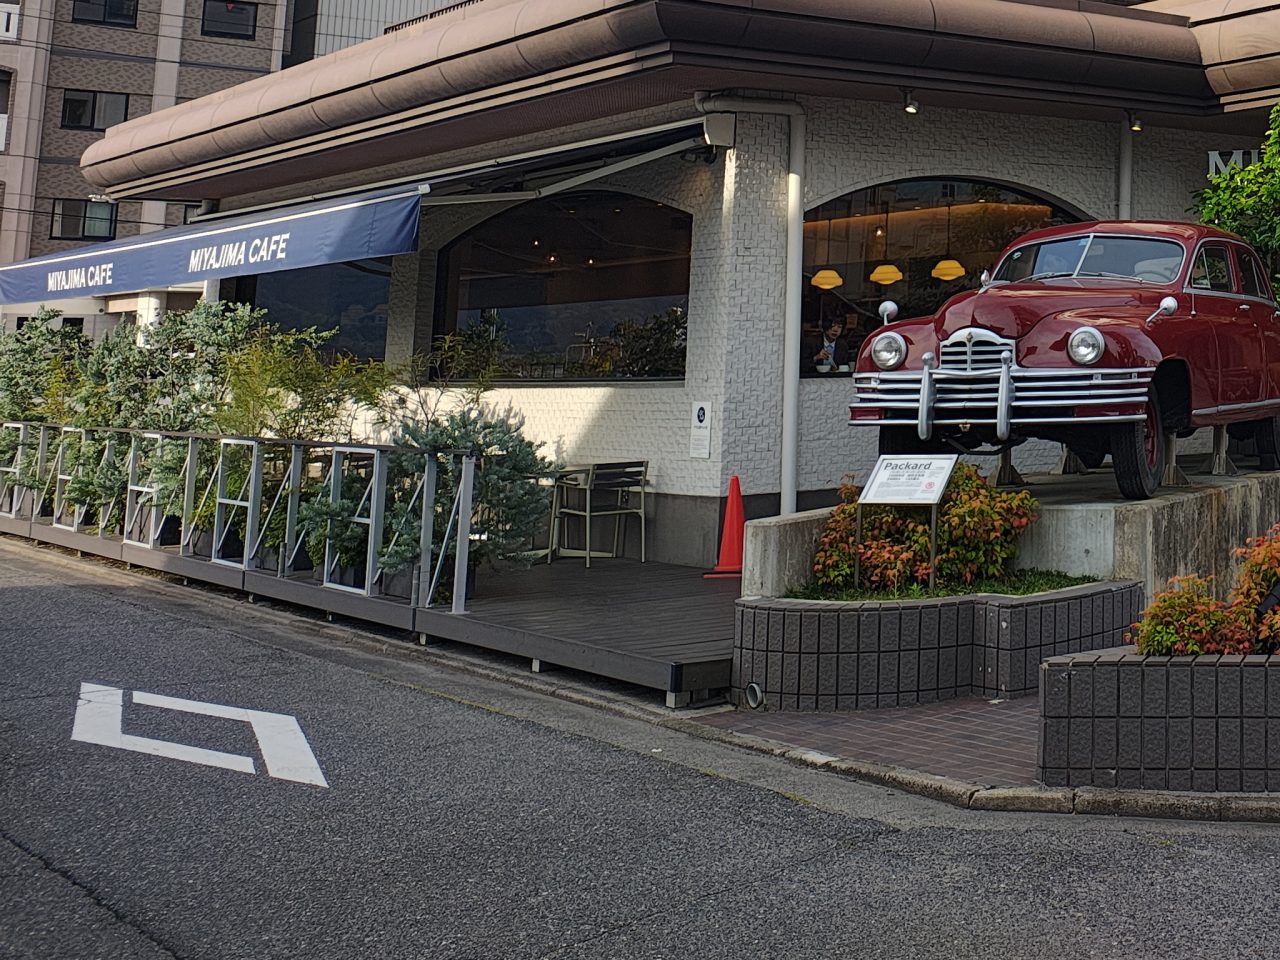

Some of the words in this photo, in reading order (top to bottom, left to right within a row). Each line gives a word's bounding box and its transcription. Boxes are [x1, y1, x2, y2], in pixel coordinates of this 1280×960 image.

[188, 240, 246, 273] MIYAJIMA
[248, 232, 290, 262] CAFE
[47, 268, 86, 292] MIYAJIMA
[87, 262, 113, 286] CAFE
[884, 461, 932, 470] Packard
